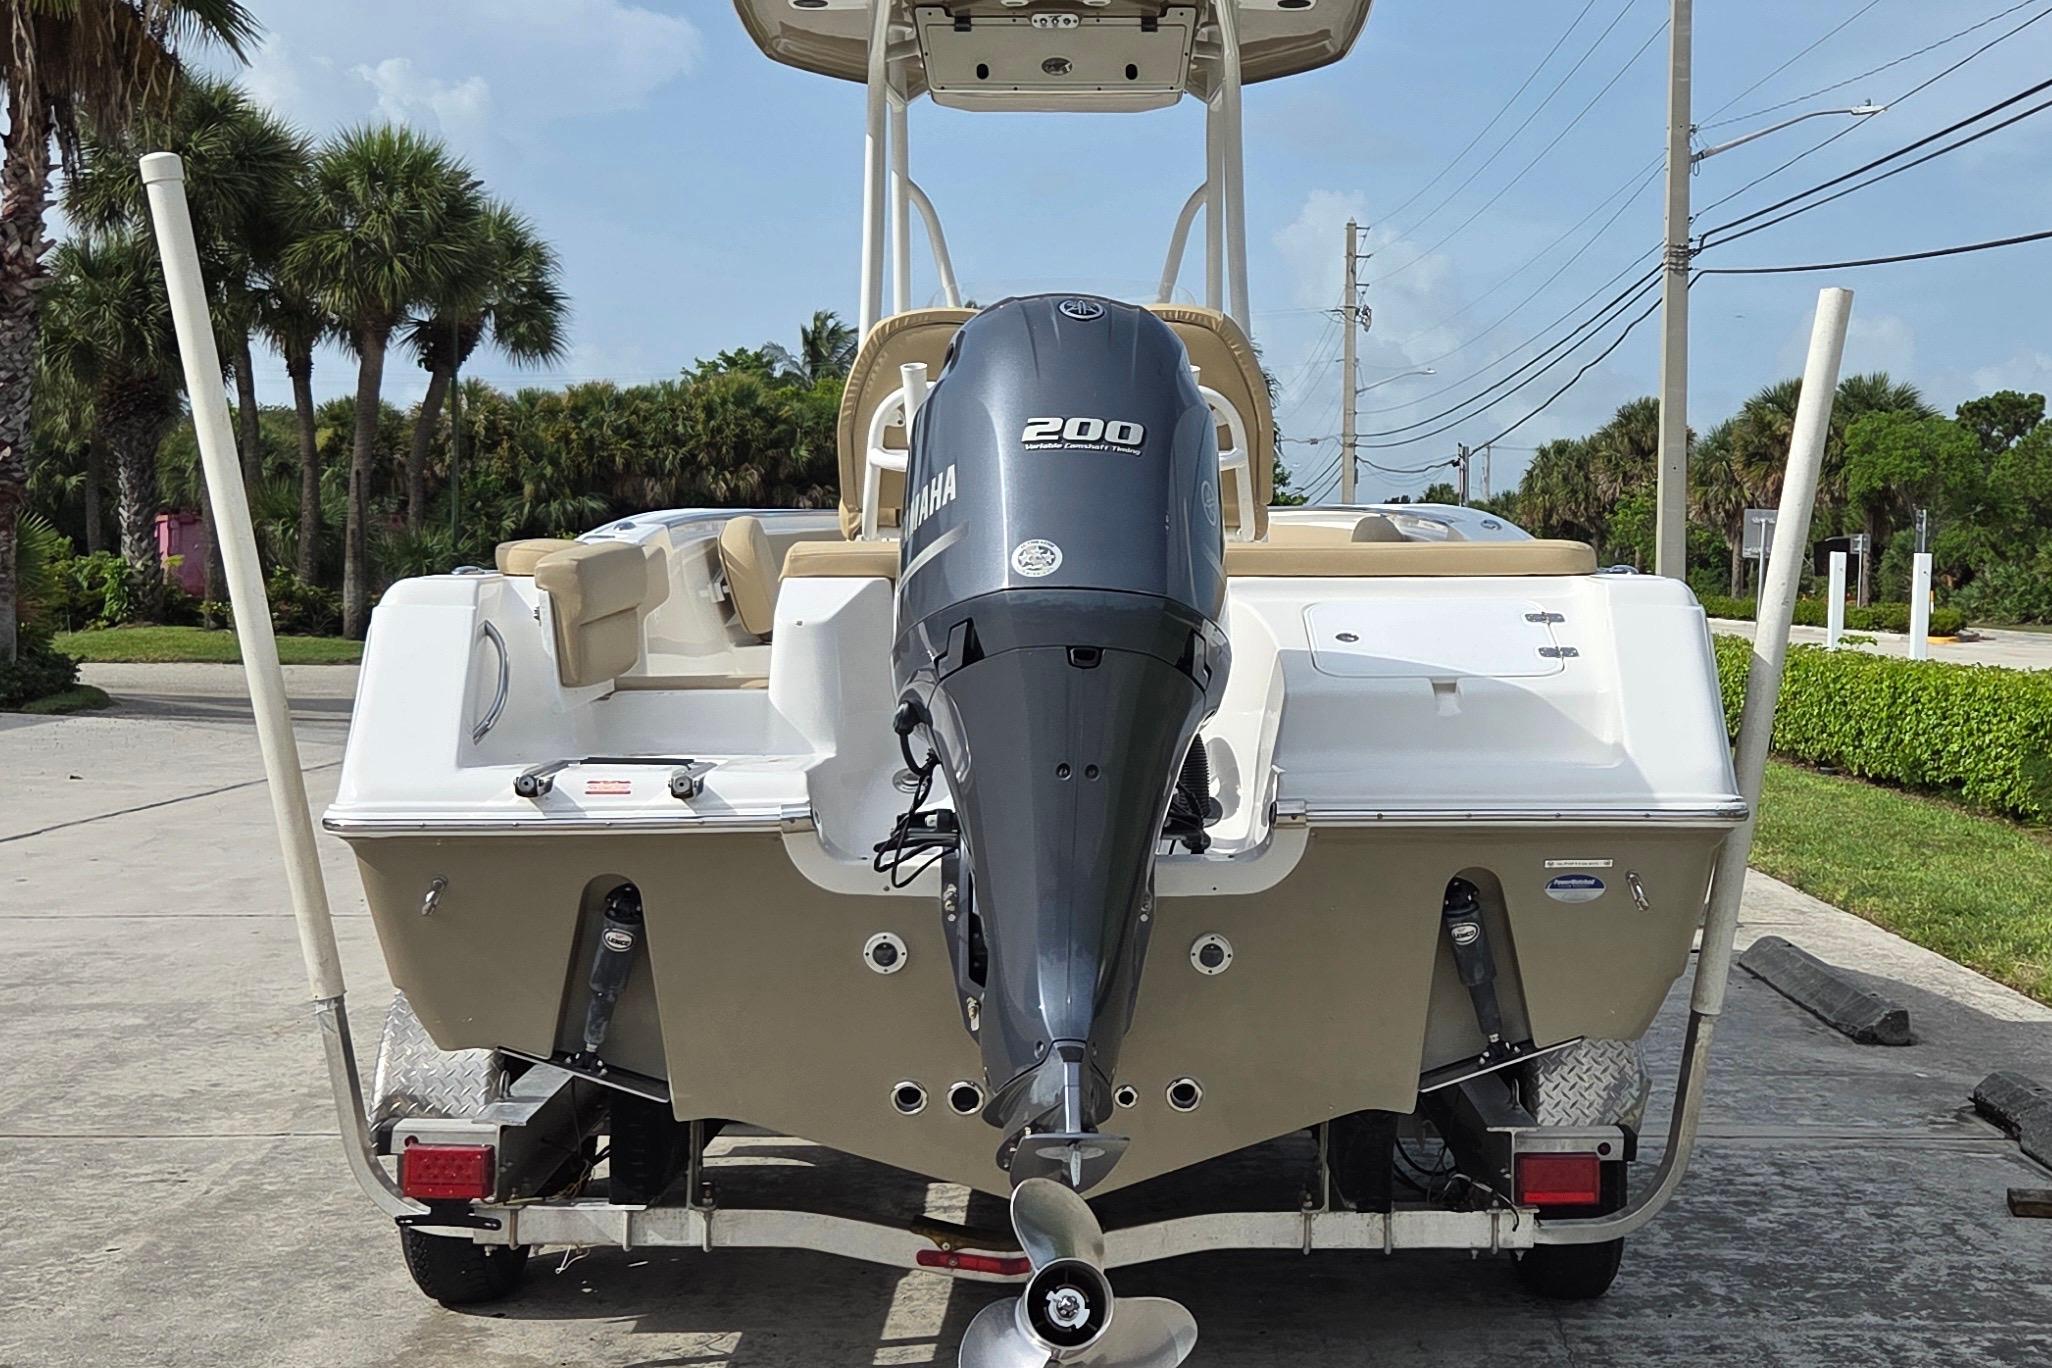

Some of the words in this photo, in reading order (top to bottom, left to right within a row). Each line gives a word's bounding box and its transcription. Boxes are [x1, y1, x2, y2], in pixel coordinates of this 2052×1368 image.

[1021, 417, 1144, 445] 200
[1064, 442, 1108, 451] Camshaft
[1111, 446, 1141, 456] Timing
